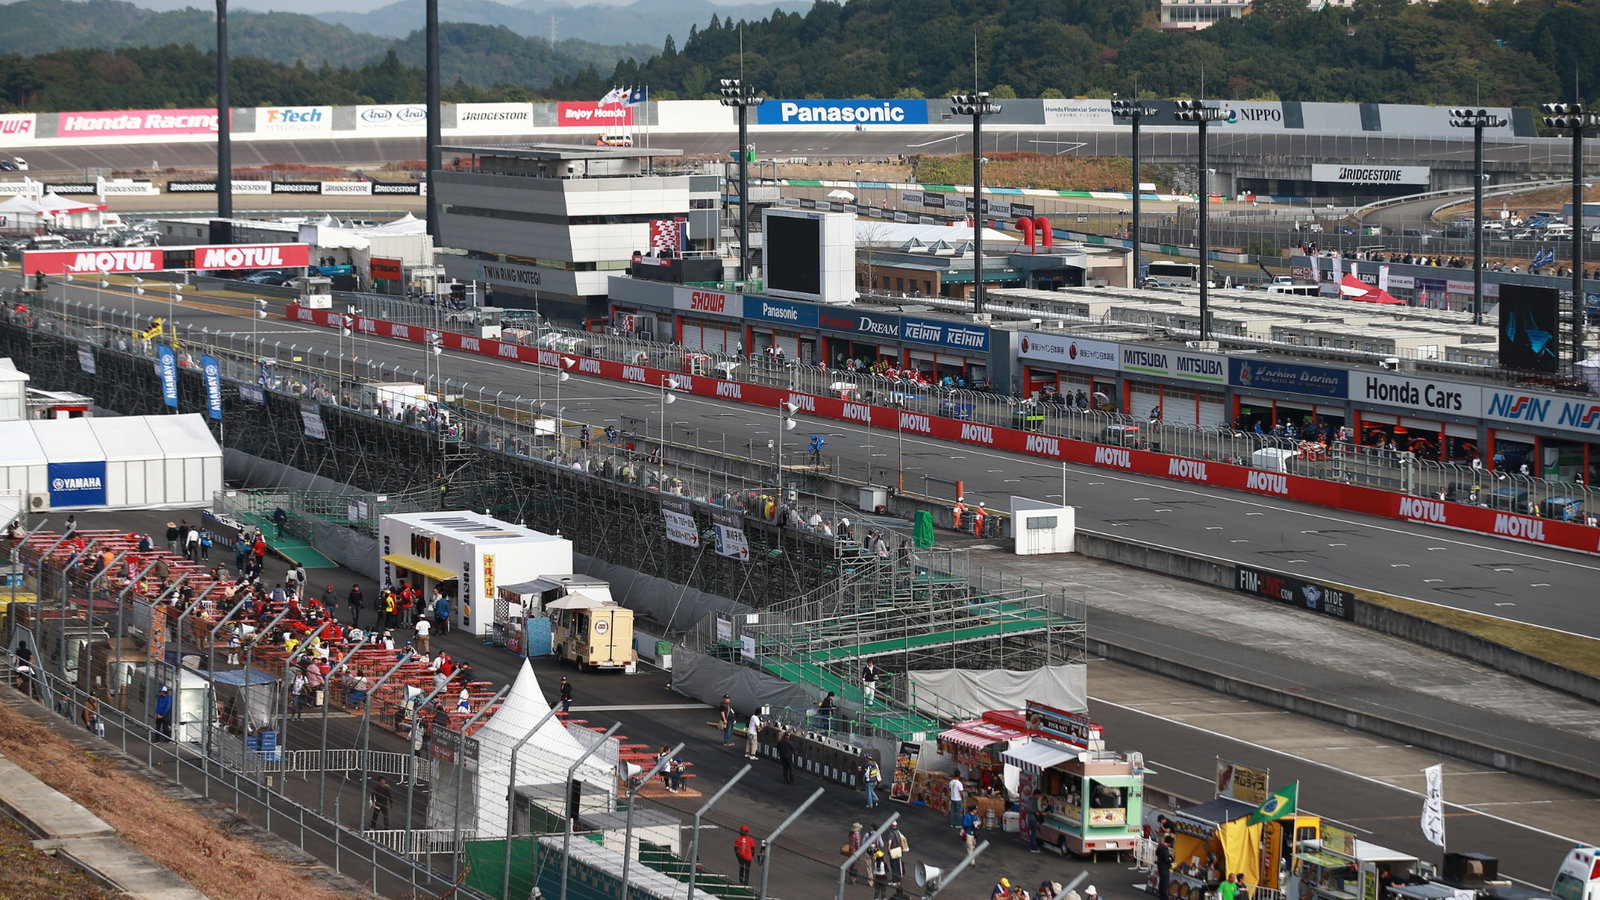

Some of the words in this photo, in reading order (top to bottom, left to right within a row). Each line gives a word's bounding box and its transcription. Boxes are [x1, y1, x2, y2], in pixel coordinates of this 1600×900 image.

[461, 112, 529, 121] BRIDGESTONE
[565, 109, 593, 119] Enjoy
[594, 109, 626, 118] Honda
[781, 102, 905, 122] Panasonic
[1240, 108, 1281, 122] NIPPO
[0, 119, 32, 134] WA
[64, 115, 142, 131] Honda
[144, 114, 219, 131] Racing
[1339, 167, 1402, 181] BRIDGESTONE
[273, 183, 320, 193] BRIDGESTONE
[325, 184, 369, 193] BRIDGESTONE
[374, 184, 419, 194] BRIDGESTONE
[74, 251, 155, 271] MOTUL
[203, 247, 283, 268] MOTUL
[483, 265, 501, 280] TWIN
[501, 269, 517, 283] RING
[517, 271, 542, 285] MOTEGI
[690, 292, 726, 313] SHOWA
[762, 303, 798, 320] Panasonic
[391, 324, 409, 338] MOTUL
[905, 322, 941, 342] KEIHIN
[946, 328, 986, 348] KEIHIN
[461, 336, 481, 352] MOTUL
[498, 343, 519, 359] MOTUL
[579, 357, 601, 374] MOTUL
[1124, 350, 1168, 369] MITSUBA
[1176, 357, 1223, 375] MITSUBA
[623, 365, 646, 382] MOTUL
[717, 381, 742, 399] MOTUL
[1366, 377, 1420, 405] Honda
[1424, 384, 1462, 411] Cars
[843, 403, 872, 422] MOTUL
[900, 413, 931, 433] MOTUL
[961, 424, 994, 443] MOTUL
[1025, 435, 1060, 456] MOTUL
[1095, 446, 1132, 468] MOTUL
[1168, 458, 1208, 481] MOTUL
[64, 477, 102, 489] YAMAHA
[1247, 470, 1288, 495] MOTUL
[1400, 497, 1447, 524] MOTUL
[1494, 514, 1545, 542] MOTUL
[485, 556, 494, 597] 沖縄そば
[1324, 589, 1343, 607] RIDE
